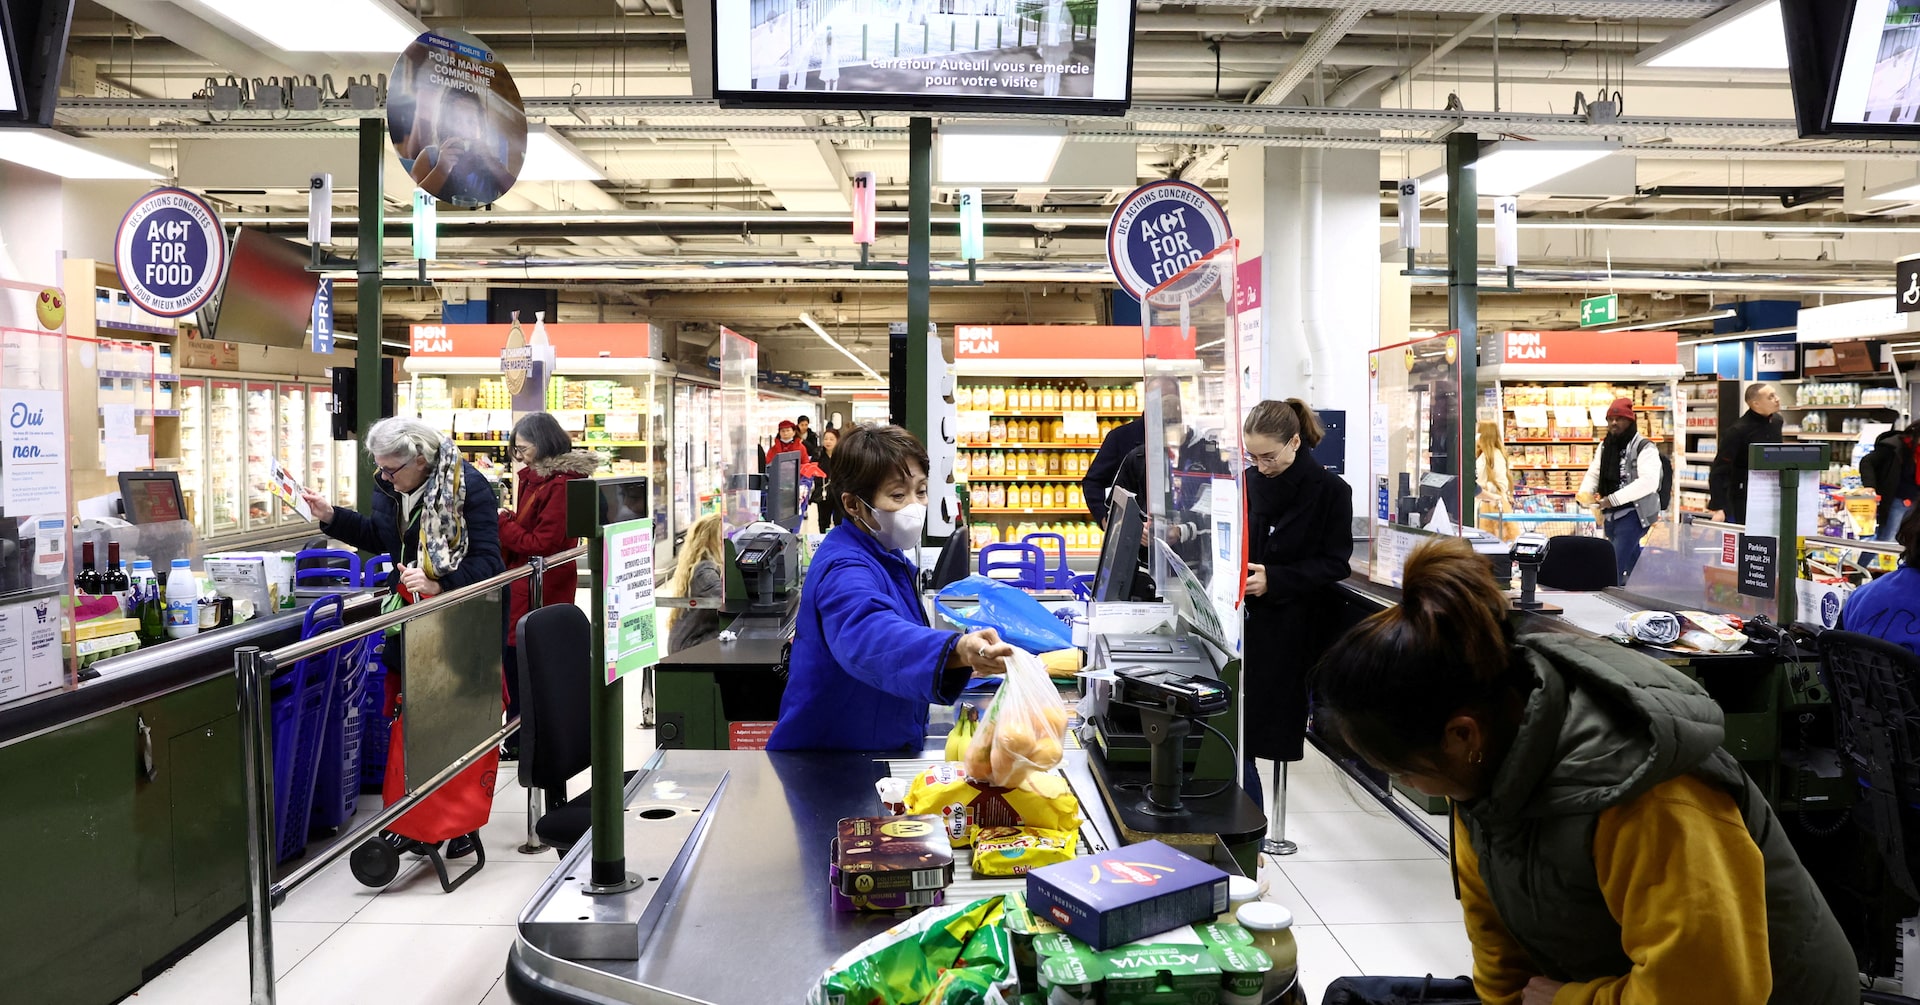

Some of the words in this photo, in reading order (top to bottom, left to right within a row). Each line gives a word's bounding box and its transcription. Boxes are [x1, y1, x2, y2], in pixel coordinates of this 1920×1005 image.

[428, 51, 456, 66] POUR
[458, 59, 496, 78] MANGER
[870, 58, 935, 72] Carrefour
[940, 59, 989, 72] Auteuil
[993, 62, 1025, 73] vous
[1029, 62, 1089, 75] remercie
[434, 64, 470, 81] COMME
[472, 74, 491, 87] UNE
[925, 74, 957, 88] pour
[961, 75, 997, 87] votre
[1001, 75, 1038, 88] visite
[430, 74, 491, 97] CHAMPIONN
[855, 177, 867, 189] 11
[1399, 183, 1415, 196] 13
[128, 212, 144, 229] DES
[142, 196, 172, 217] ACTIONS
[1117, 217, 1130, 236] DES
[1128, 191, 1156, 219] ACTIONS
[1499, 202, 1515, 214] 14
[151, 241, 187, 263] FOR
[1149, 230, 1192, 262] FOR
[145, 263, 193, 286] FOOD
[133, 284, 151, 304] POUR
[152, 298, 175, 310] MIEUX
[176, 286, 205, 308] MANGER
[413, 325, 447, 339] BON
[958, 327, 993, 341] BON
[1507, 332, 1541, 346] BON
[413, 339, 453, 353] PLAN
[958, 340, 1000, 354] PLAN
[1507, 345, 1547, 359] PLAN
[10, 401, 44, 429] Oui
[12, 445, 42, 459] non
[1747, 543, 1768, 555] Parking
[1744, 554, 1762, 562] gratuit
[1109, 955, 1202, 970] ACTIVIA
